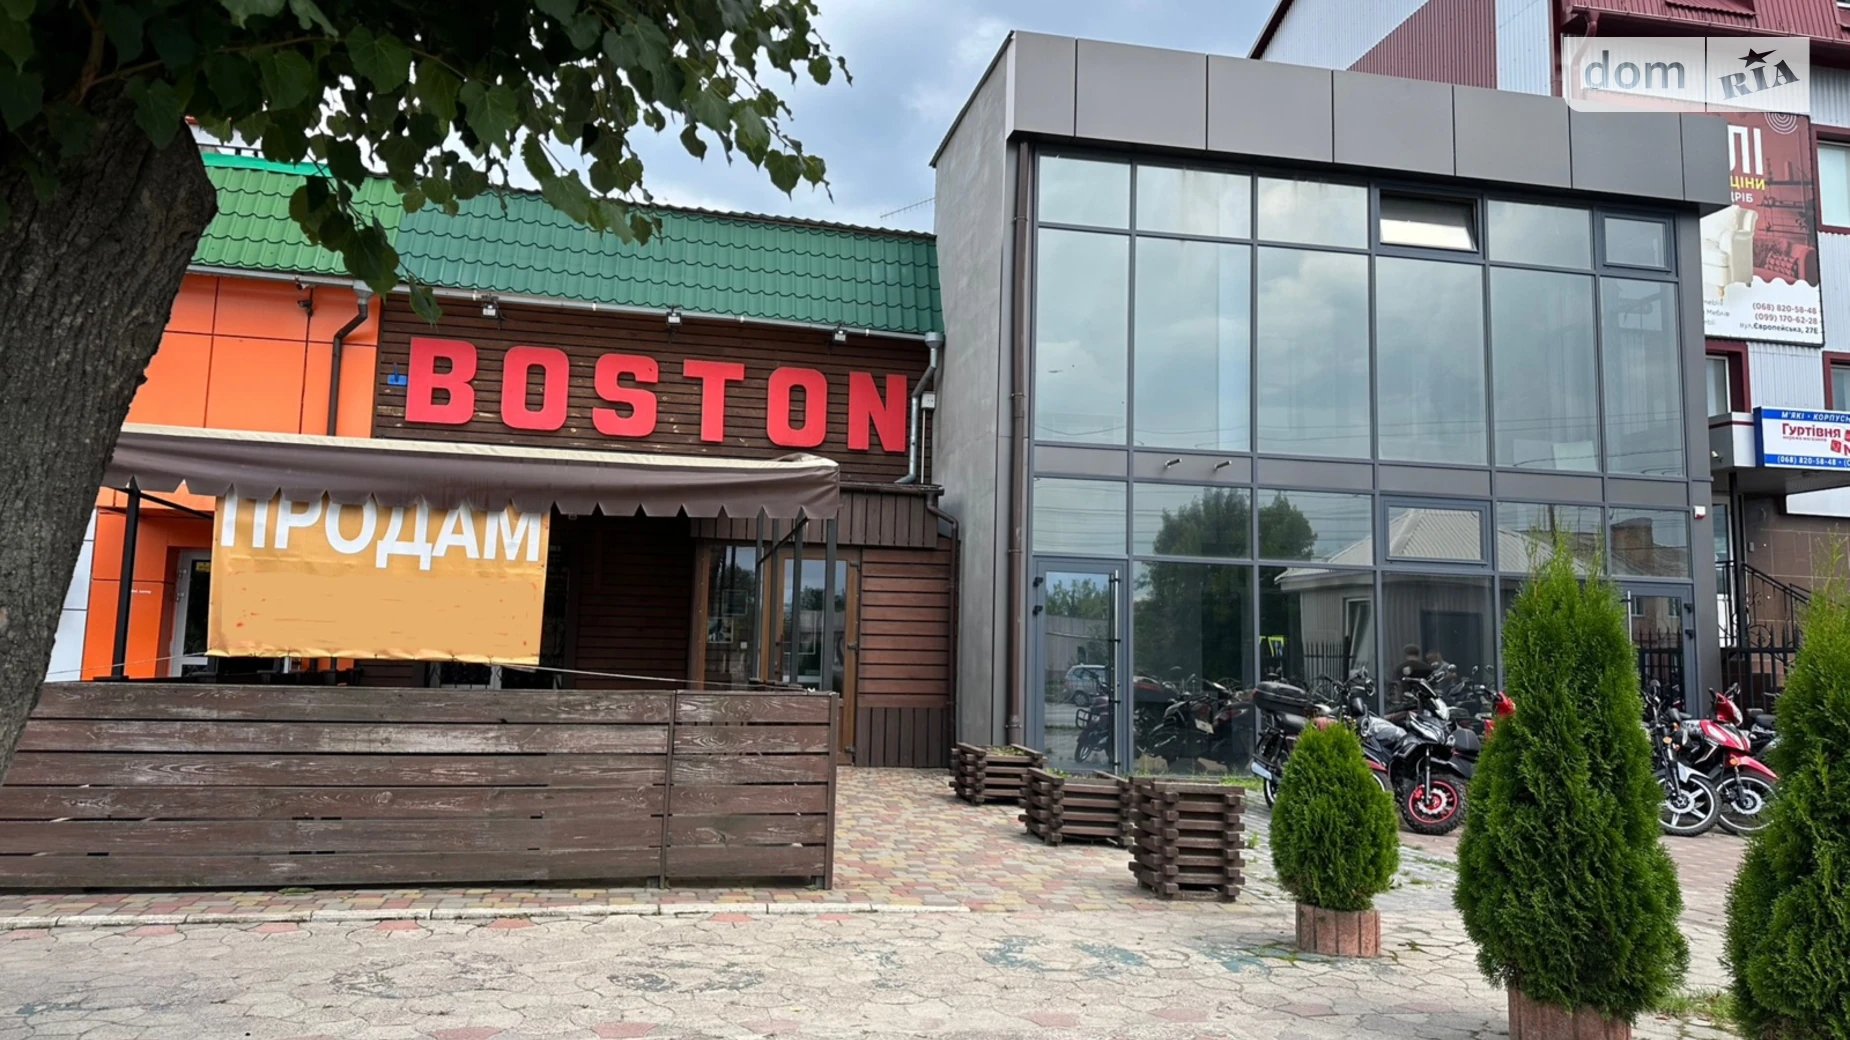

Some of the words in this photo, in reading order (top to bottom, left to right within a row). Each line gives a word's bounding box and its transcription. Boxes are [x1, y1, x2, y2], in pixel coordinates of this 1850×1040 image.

[1730, 175, 1765, 190] ЦІНИ
[405, 336, 908, 453] BOSTON
[1782, 422, 1841, 438] Гуртівня
[220, 485, 542, 571] ПРОДАМ
